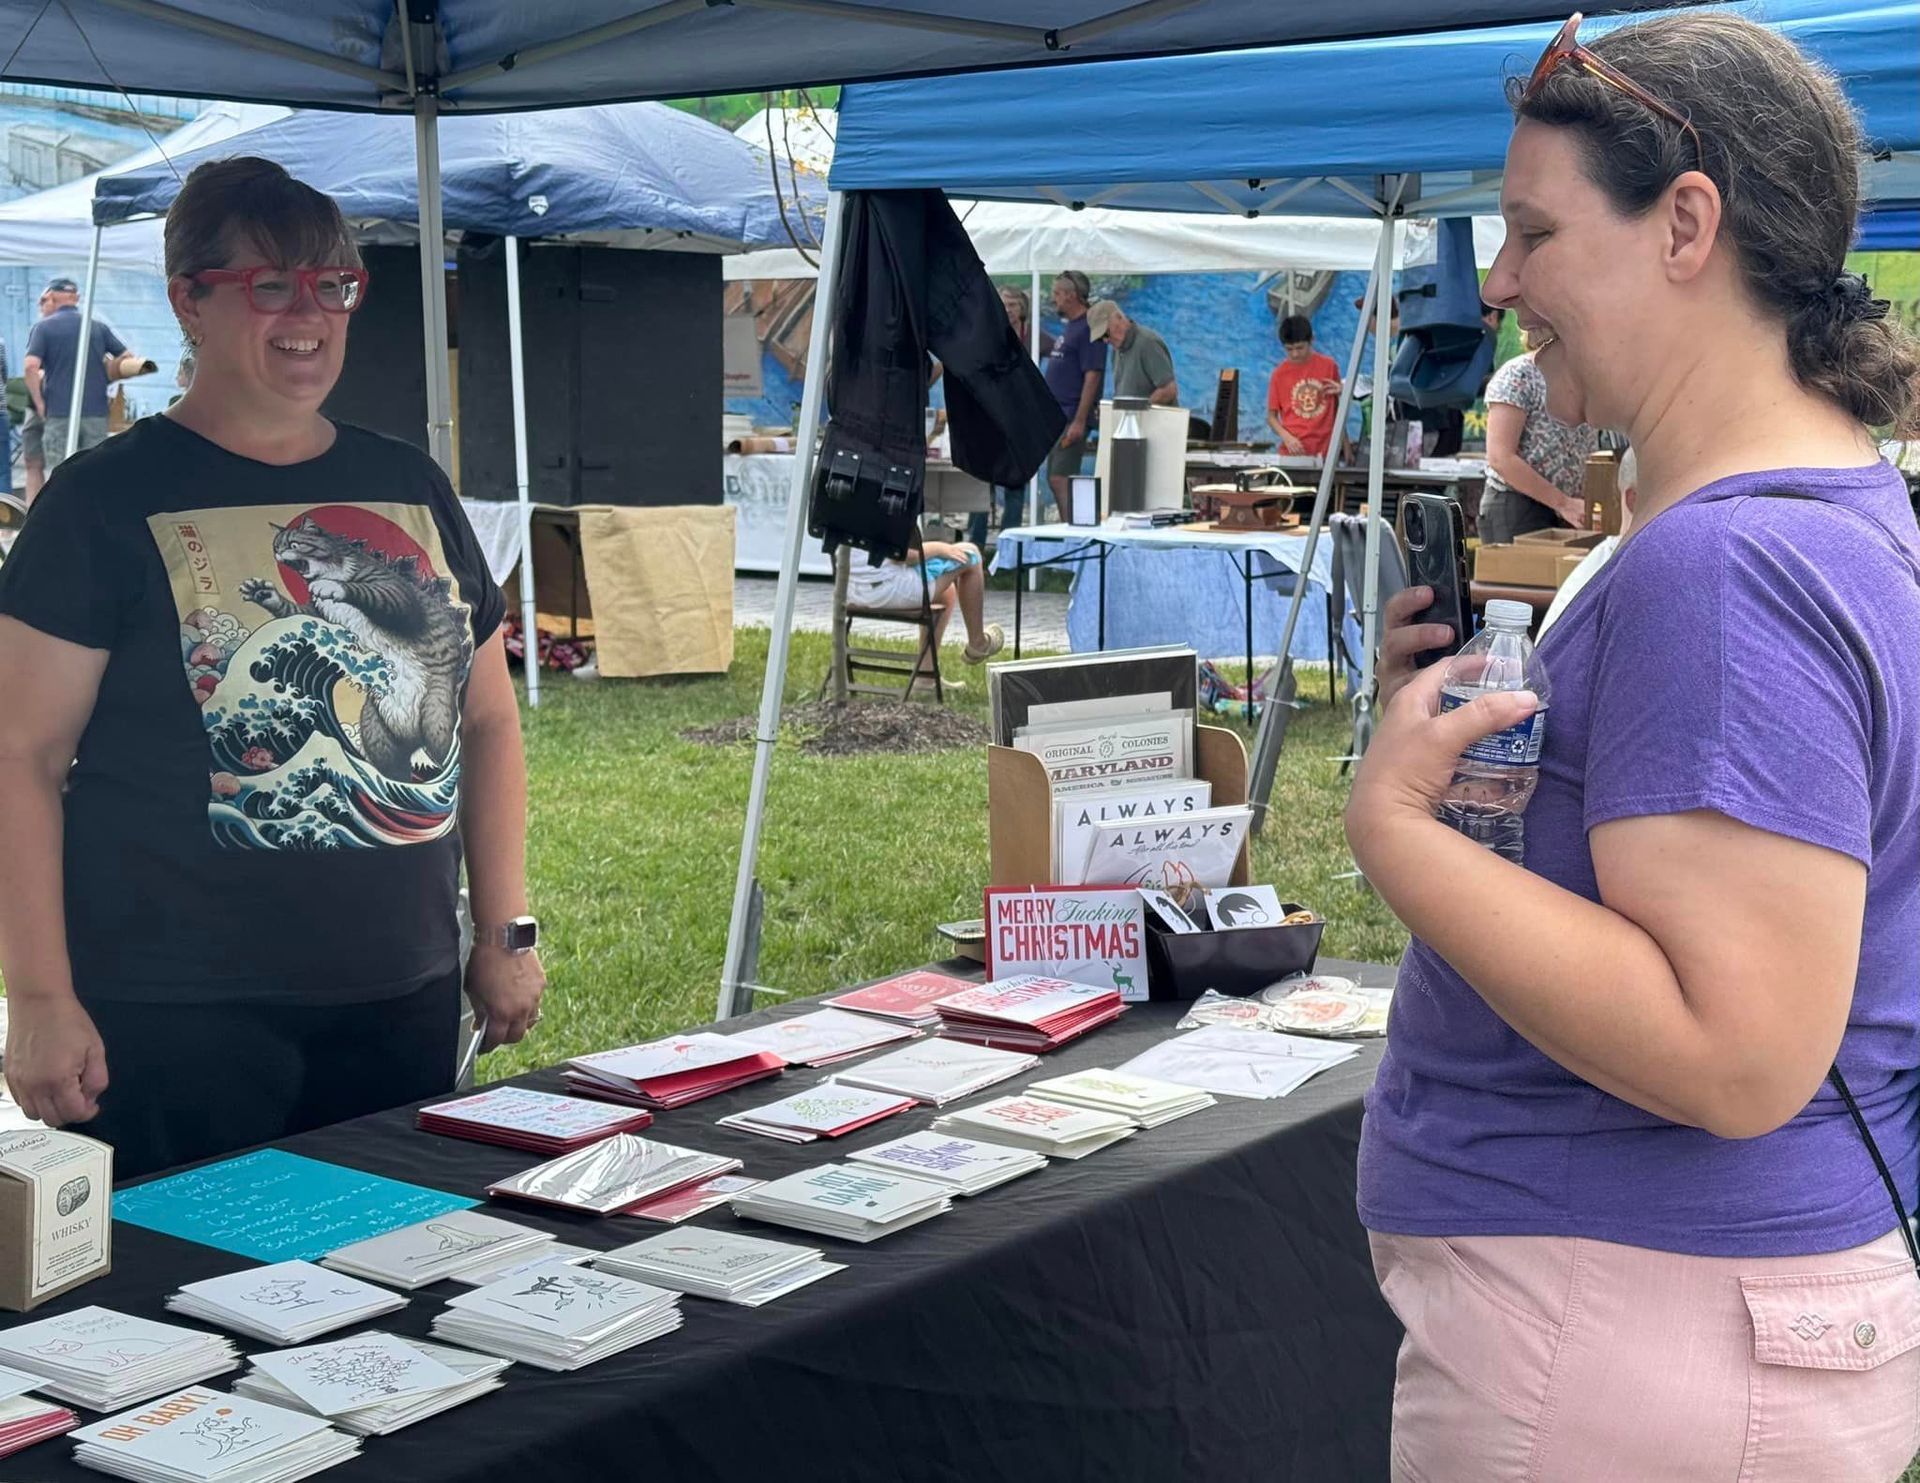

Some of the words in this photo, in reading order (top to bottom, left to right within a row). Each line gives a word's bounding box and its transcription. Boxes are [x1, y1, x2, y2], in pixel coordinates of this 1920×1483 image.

[1045, 745, 1095, 759] ORIGINAL
[1121, 736, 1169, 750] COLONIES
[1077, 796, 1195, 826] ALWAYS
[1110, 822, 1233, 848] ALWAYS
[998, 898, 1056, 924] MERRY
[1055, 899, 1138, 928] Fucking
[999, 923, 1140, 962] CHRISTMAS
[803, 1170, 862, 1189] HOT
[811, 1177, 900, 1206] DAMN!
[51, 1216, 93, 1242] WHISKY
[98, 1423, 151, 1442] OH
[132, 1392, 218, 1426] BABY!
